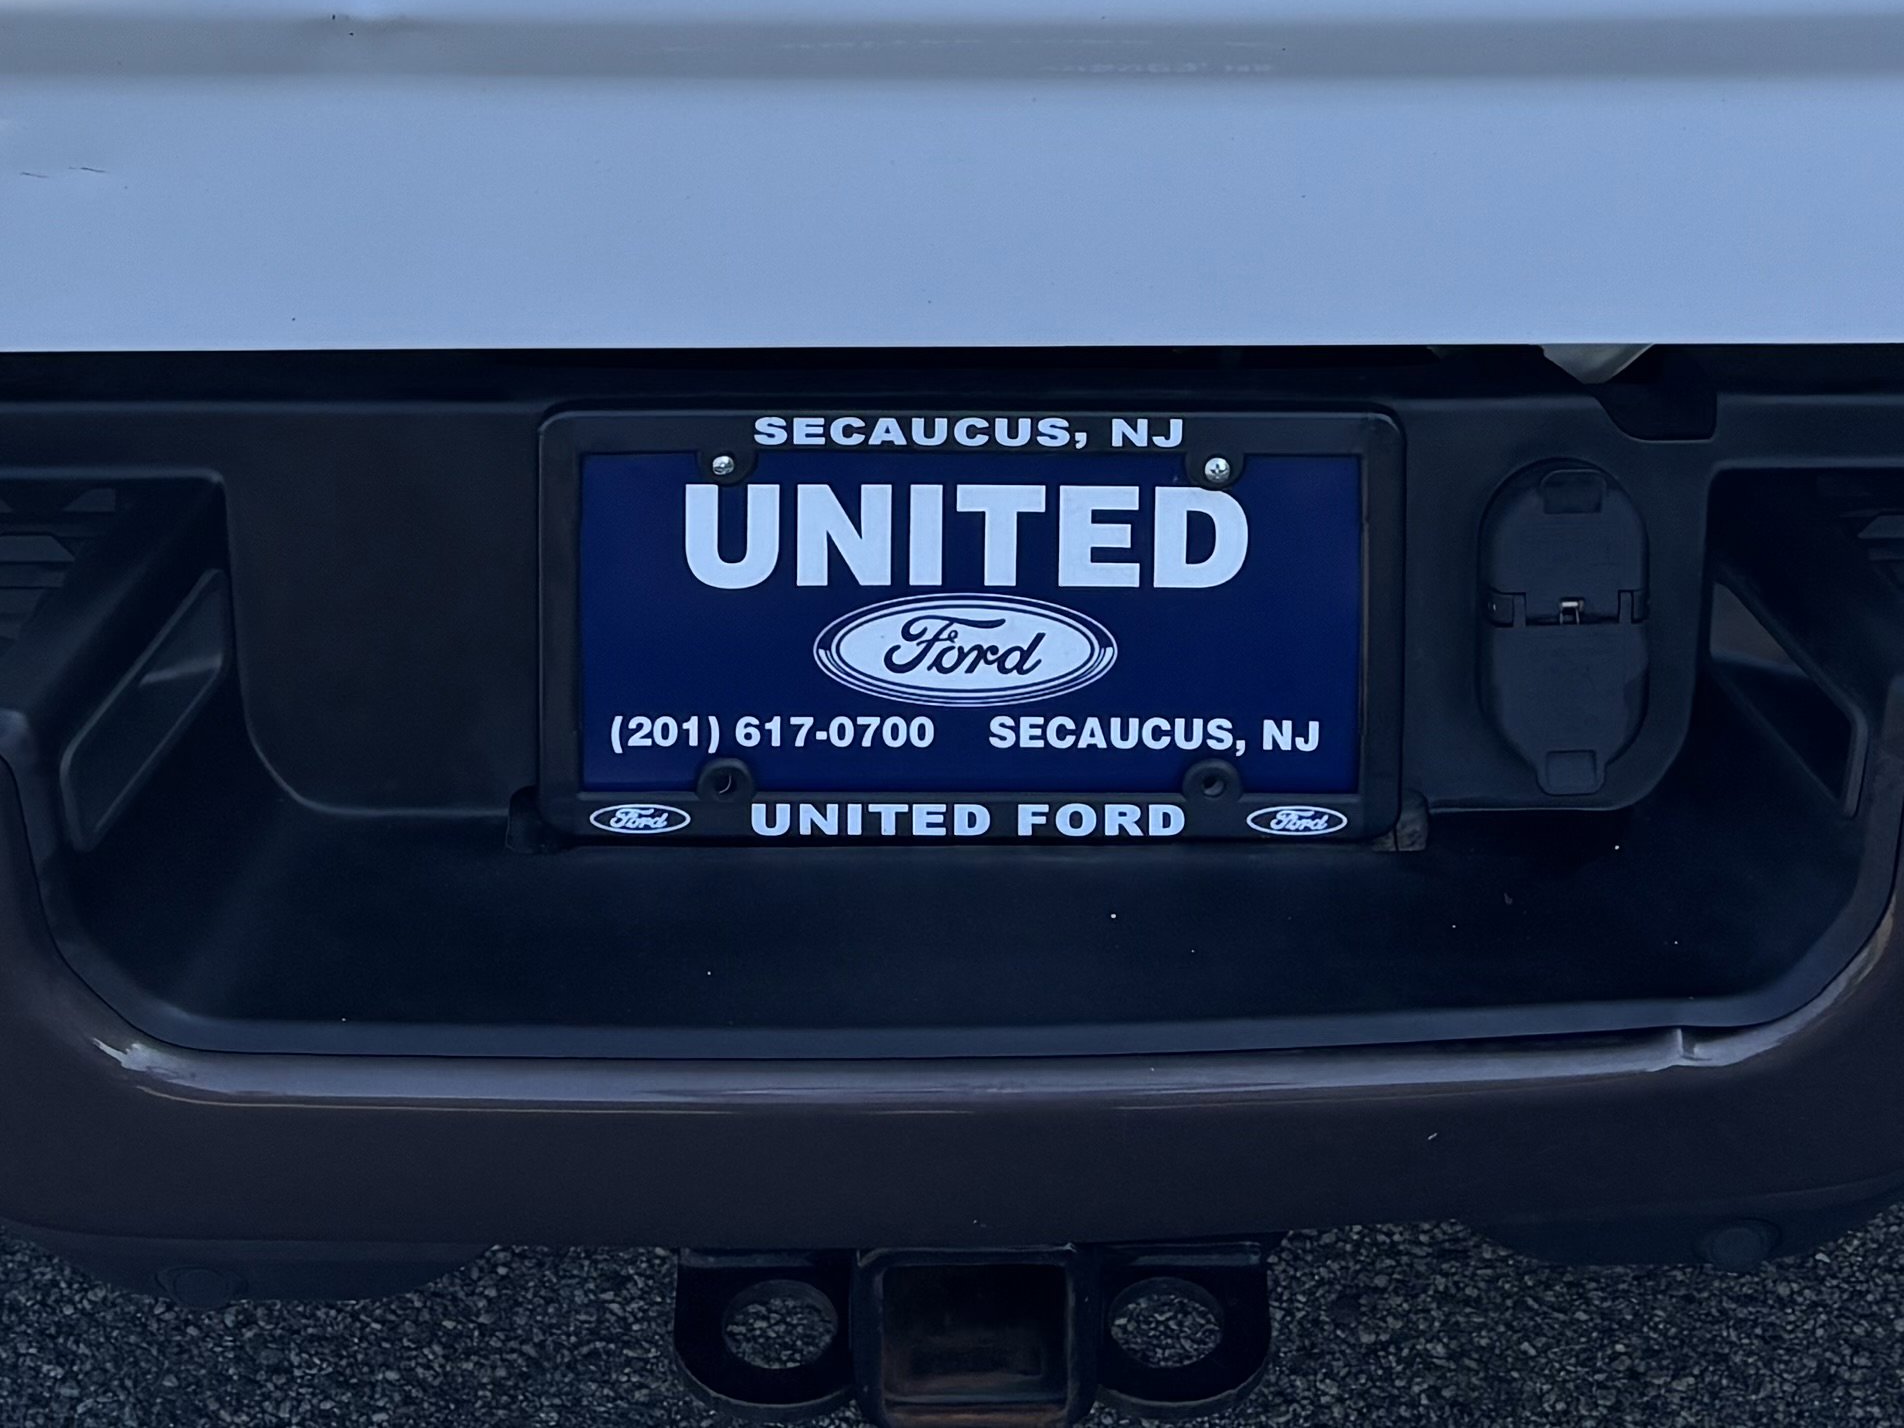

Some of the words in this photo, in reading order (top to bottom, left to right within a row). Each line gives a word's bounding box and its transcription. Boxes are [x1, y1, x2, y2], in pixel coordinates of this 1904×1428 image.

[754, 416, 1087, 449] SECAUCUS,
[1111, 418, 1184, 448] NJ
[685, 483, 1249, 590] UNITED
[882, 613, 1047, 676] Ford
[610, 715, 721, 754] (201)
[735, 715, 935, 748] 617-0700
[988, 715, 1246, 757] SECAUCUS,
[1262, 719, 1321, 752] NJ
[609, 808, 669, 829] Ford
[751, 803, 991, 836] UNITED
[1017, 803, 1185, 837] FORD
[1269, 810, 1329, 831] Ford
